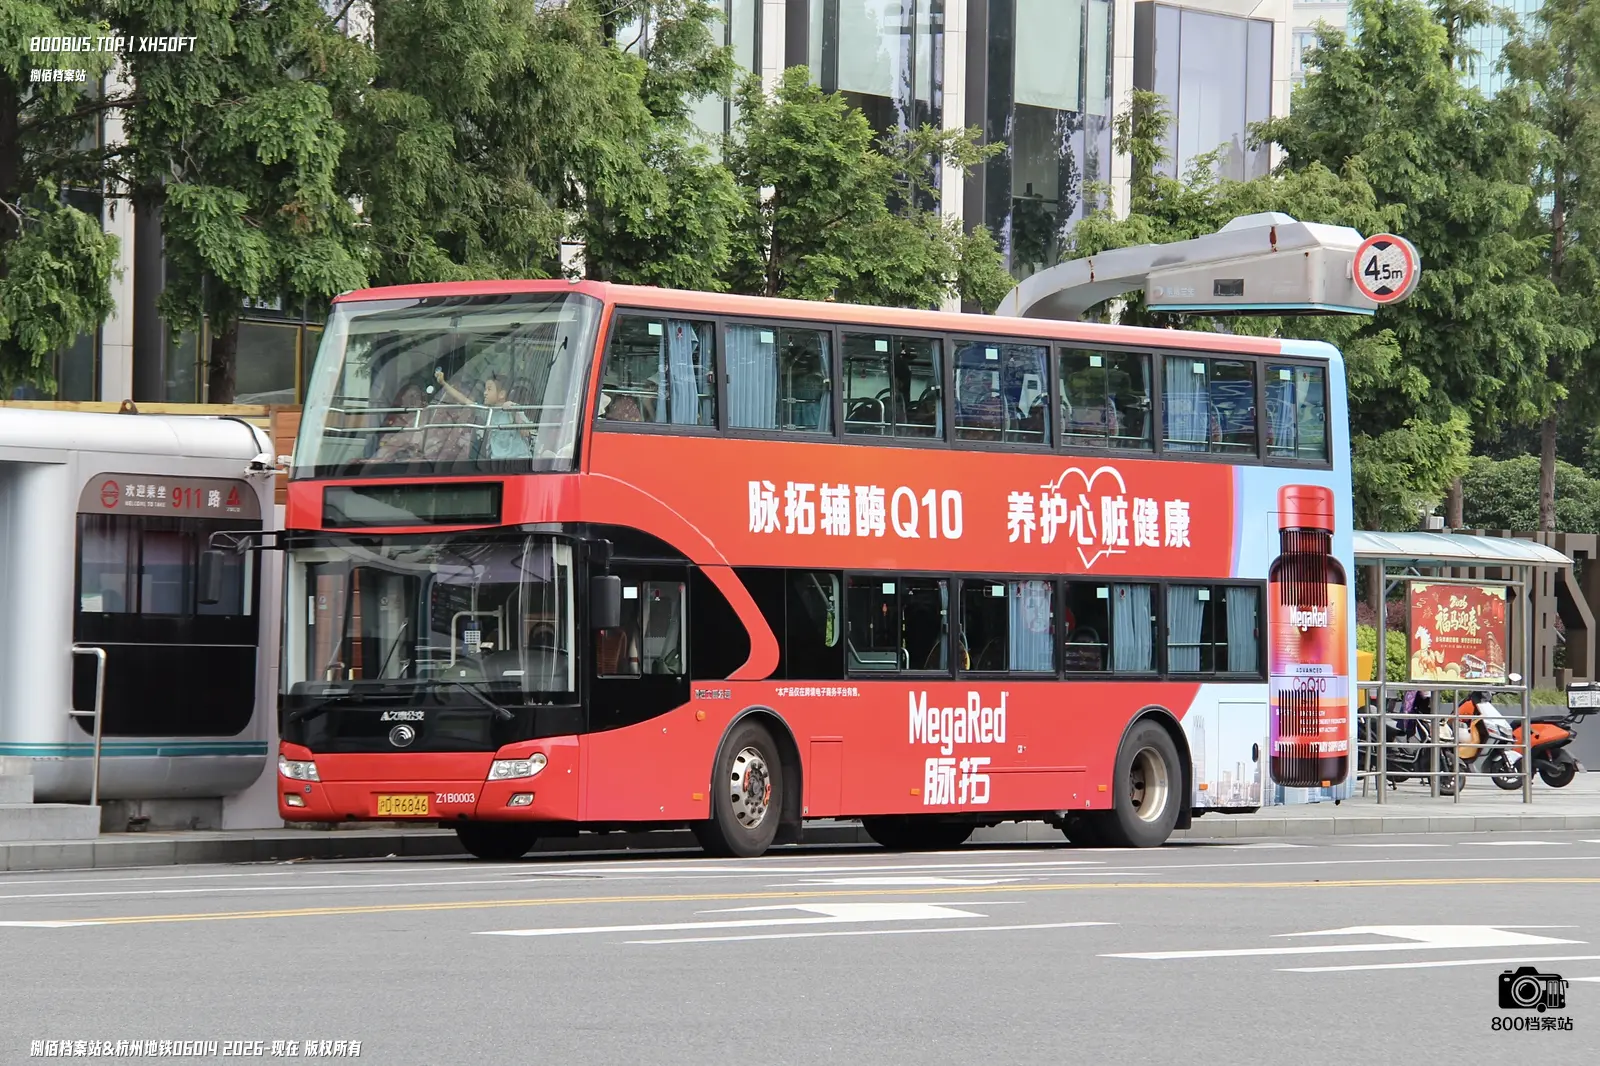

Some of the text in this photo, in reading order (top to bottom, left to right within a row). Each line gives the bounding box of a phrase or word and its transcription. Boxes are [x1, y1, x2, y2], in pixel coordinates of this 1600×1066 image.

[125, 484, 221, 509] 欢迎乘坐 911 路
[748, 480, 1191, 548] 脉拓辅酶Q10 养护心脏健康
[435, 793, 475, 804] Z1B0003
[924, 757, 991, 805] 脉拓
